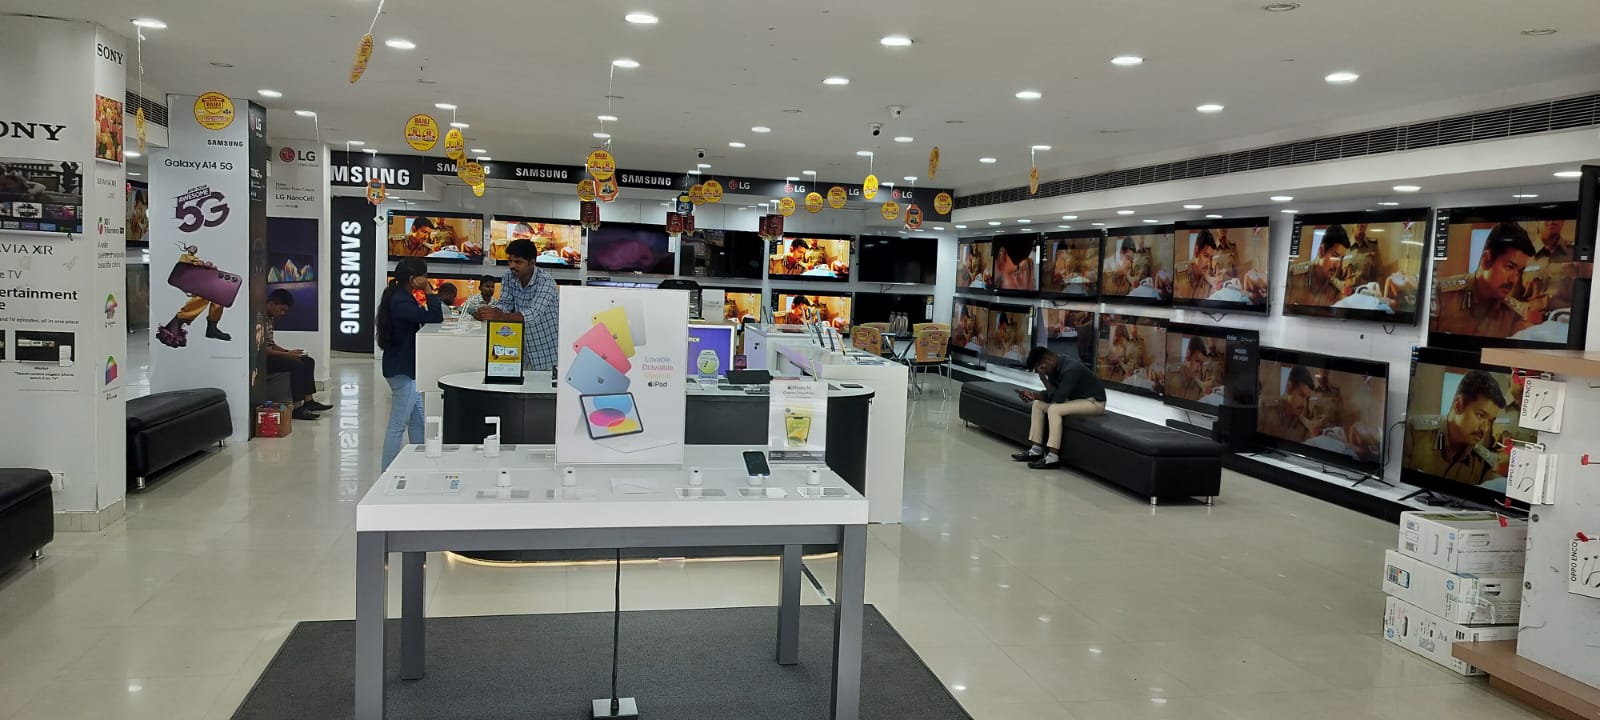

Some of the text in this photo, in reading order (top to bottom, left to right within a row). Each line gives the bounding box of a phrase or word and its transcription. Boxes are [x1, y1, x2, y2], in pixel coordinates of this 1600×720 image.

[97, 42, 123, 65] SONY
[207, 139, 244, 147] SAMSUNG
[298, 150, 316, 162] LG
[164, 158, 234, 171] Galaxy A14 5G
[436, 162, 491, 174] SAMG
[331, 165, 410, 186] MSUNG
[515, 167, 568, 179] SAMSUNG
[621, 173, 672, 186] SAMSUNG
[738, 181, 751, 190] LG
[794, 185, 806, 193] LG
[848, 188, 860, 196] LG
[902, 191, 913, 199] LG
[176, 191, 230, 233] 5G
[0, 243, 53, 255] VIA XR
[8, 270, 22, 280] TV
[340, 220, 362, 335] SAMSUNG
[0, 288, 79, 300] ertainment
[1521, 398, 1529, 417] OPPO
[1570, 562, 1578, 582] OPPO
